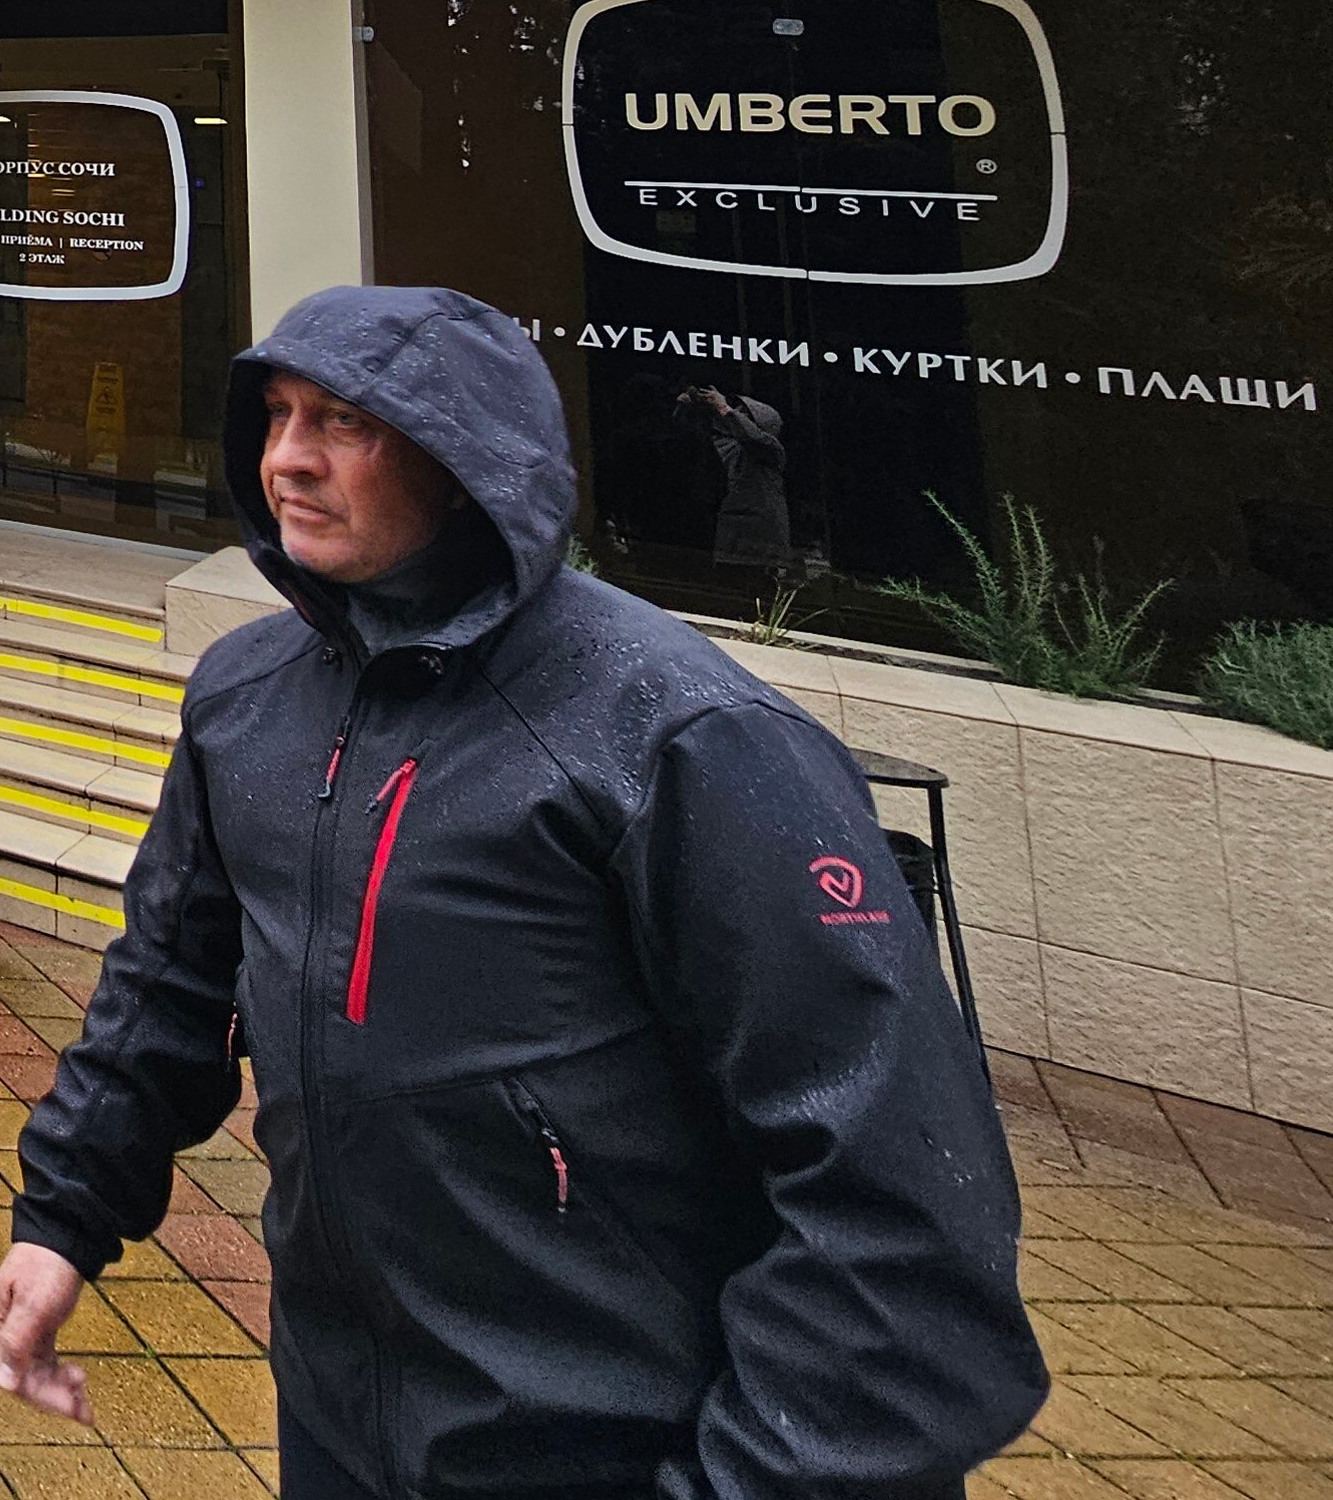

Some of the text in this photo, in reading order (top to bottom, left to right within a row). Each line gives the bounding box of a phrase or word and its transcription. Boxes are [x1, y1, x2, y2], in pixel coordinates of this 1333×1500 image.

[624, 93, 997, 137] UMBERTO
[57, 161, 116, 177] СОЧИ
[638, 188, 981, 221] EXCLUSIVE
[62, 212, 126, 227] SOCHI
[0, 235, 53, 247] ПРИЁМА
[69, 238, 145, 251] RECEPTION
[19, 254, 65, 264] 2 ЭТАЖ
[576, 323, 810, 367] ДУБЛЕНКИ
[853, 347, 1048, 388] КУРТКИ
[1098, 367, 1317, 411] ПЛАЩИ
